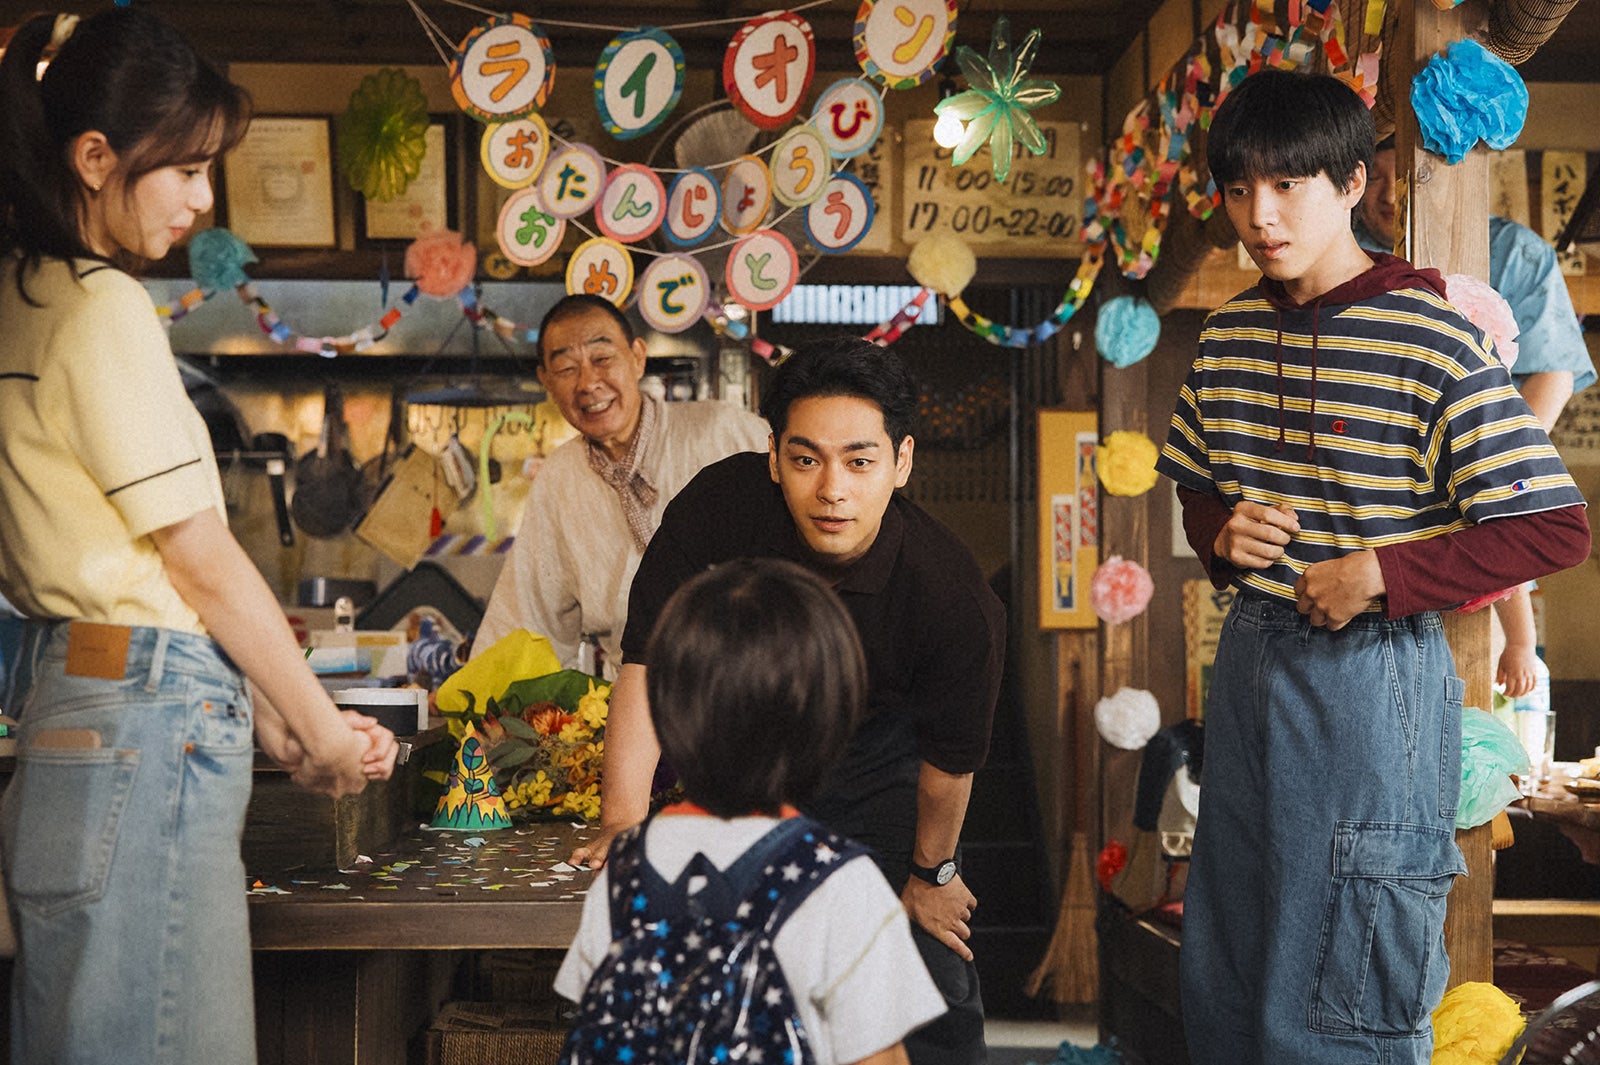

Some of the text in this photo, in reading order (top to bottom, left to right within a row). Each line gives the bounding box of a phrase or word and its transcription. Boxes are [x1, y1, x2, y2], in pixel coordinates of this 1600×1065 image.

[479, 5, 935, 118] ライオン
[503, 102, 872, 229] おたんじょうび
[514, 191, 854, 315] おめでとう
